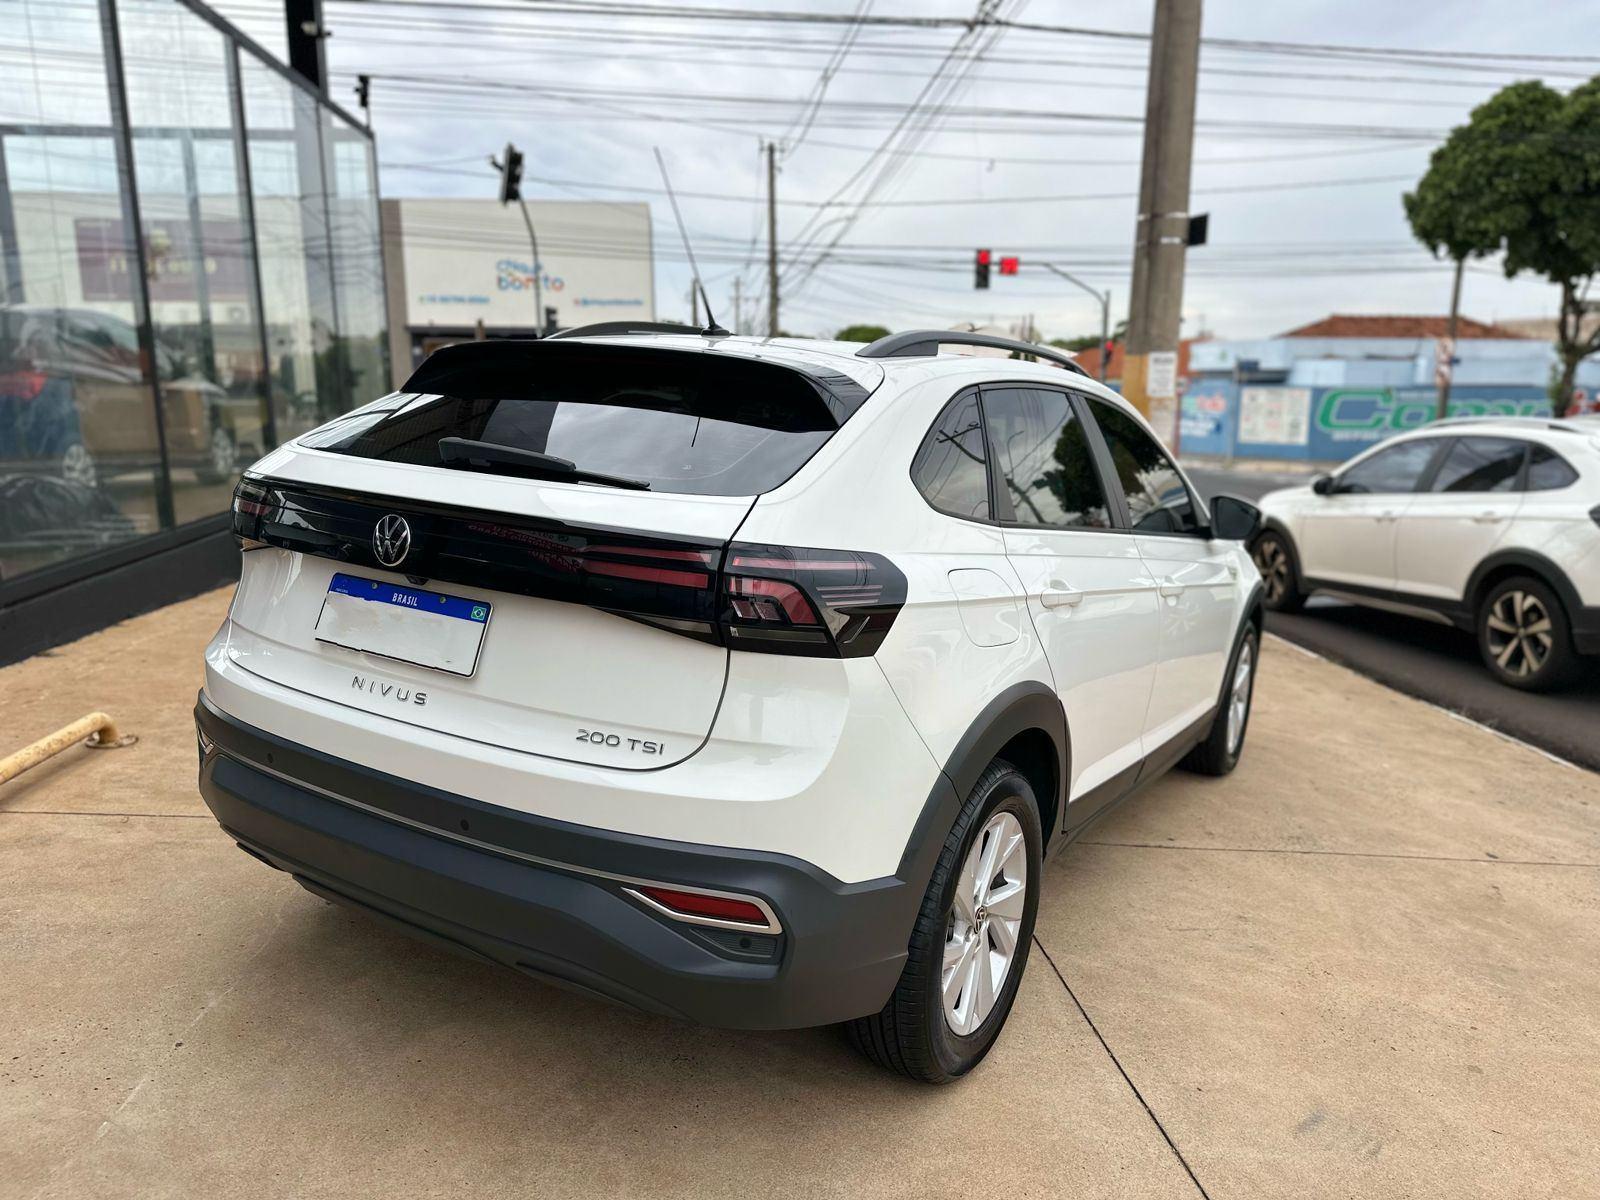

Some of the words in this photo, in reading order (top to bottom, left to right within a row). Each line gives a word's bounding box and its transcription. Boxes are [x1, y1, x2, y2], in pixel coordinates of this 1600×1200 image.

[392, 592, 418, 607] BRASIL
[352, 676, 428, 706] NIVUS
[576, 728, 620, 747] 200
[627, 737, 664, 756] TSI
